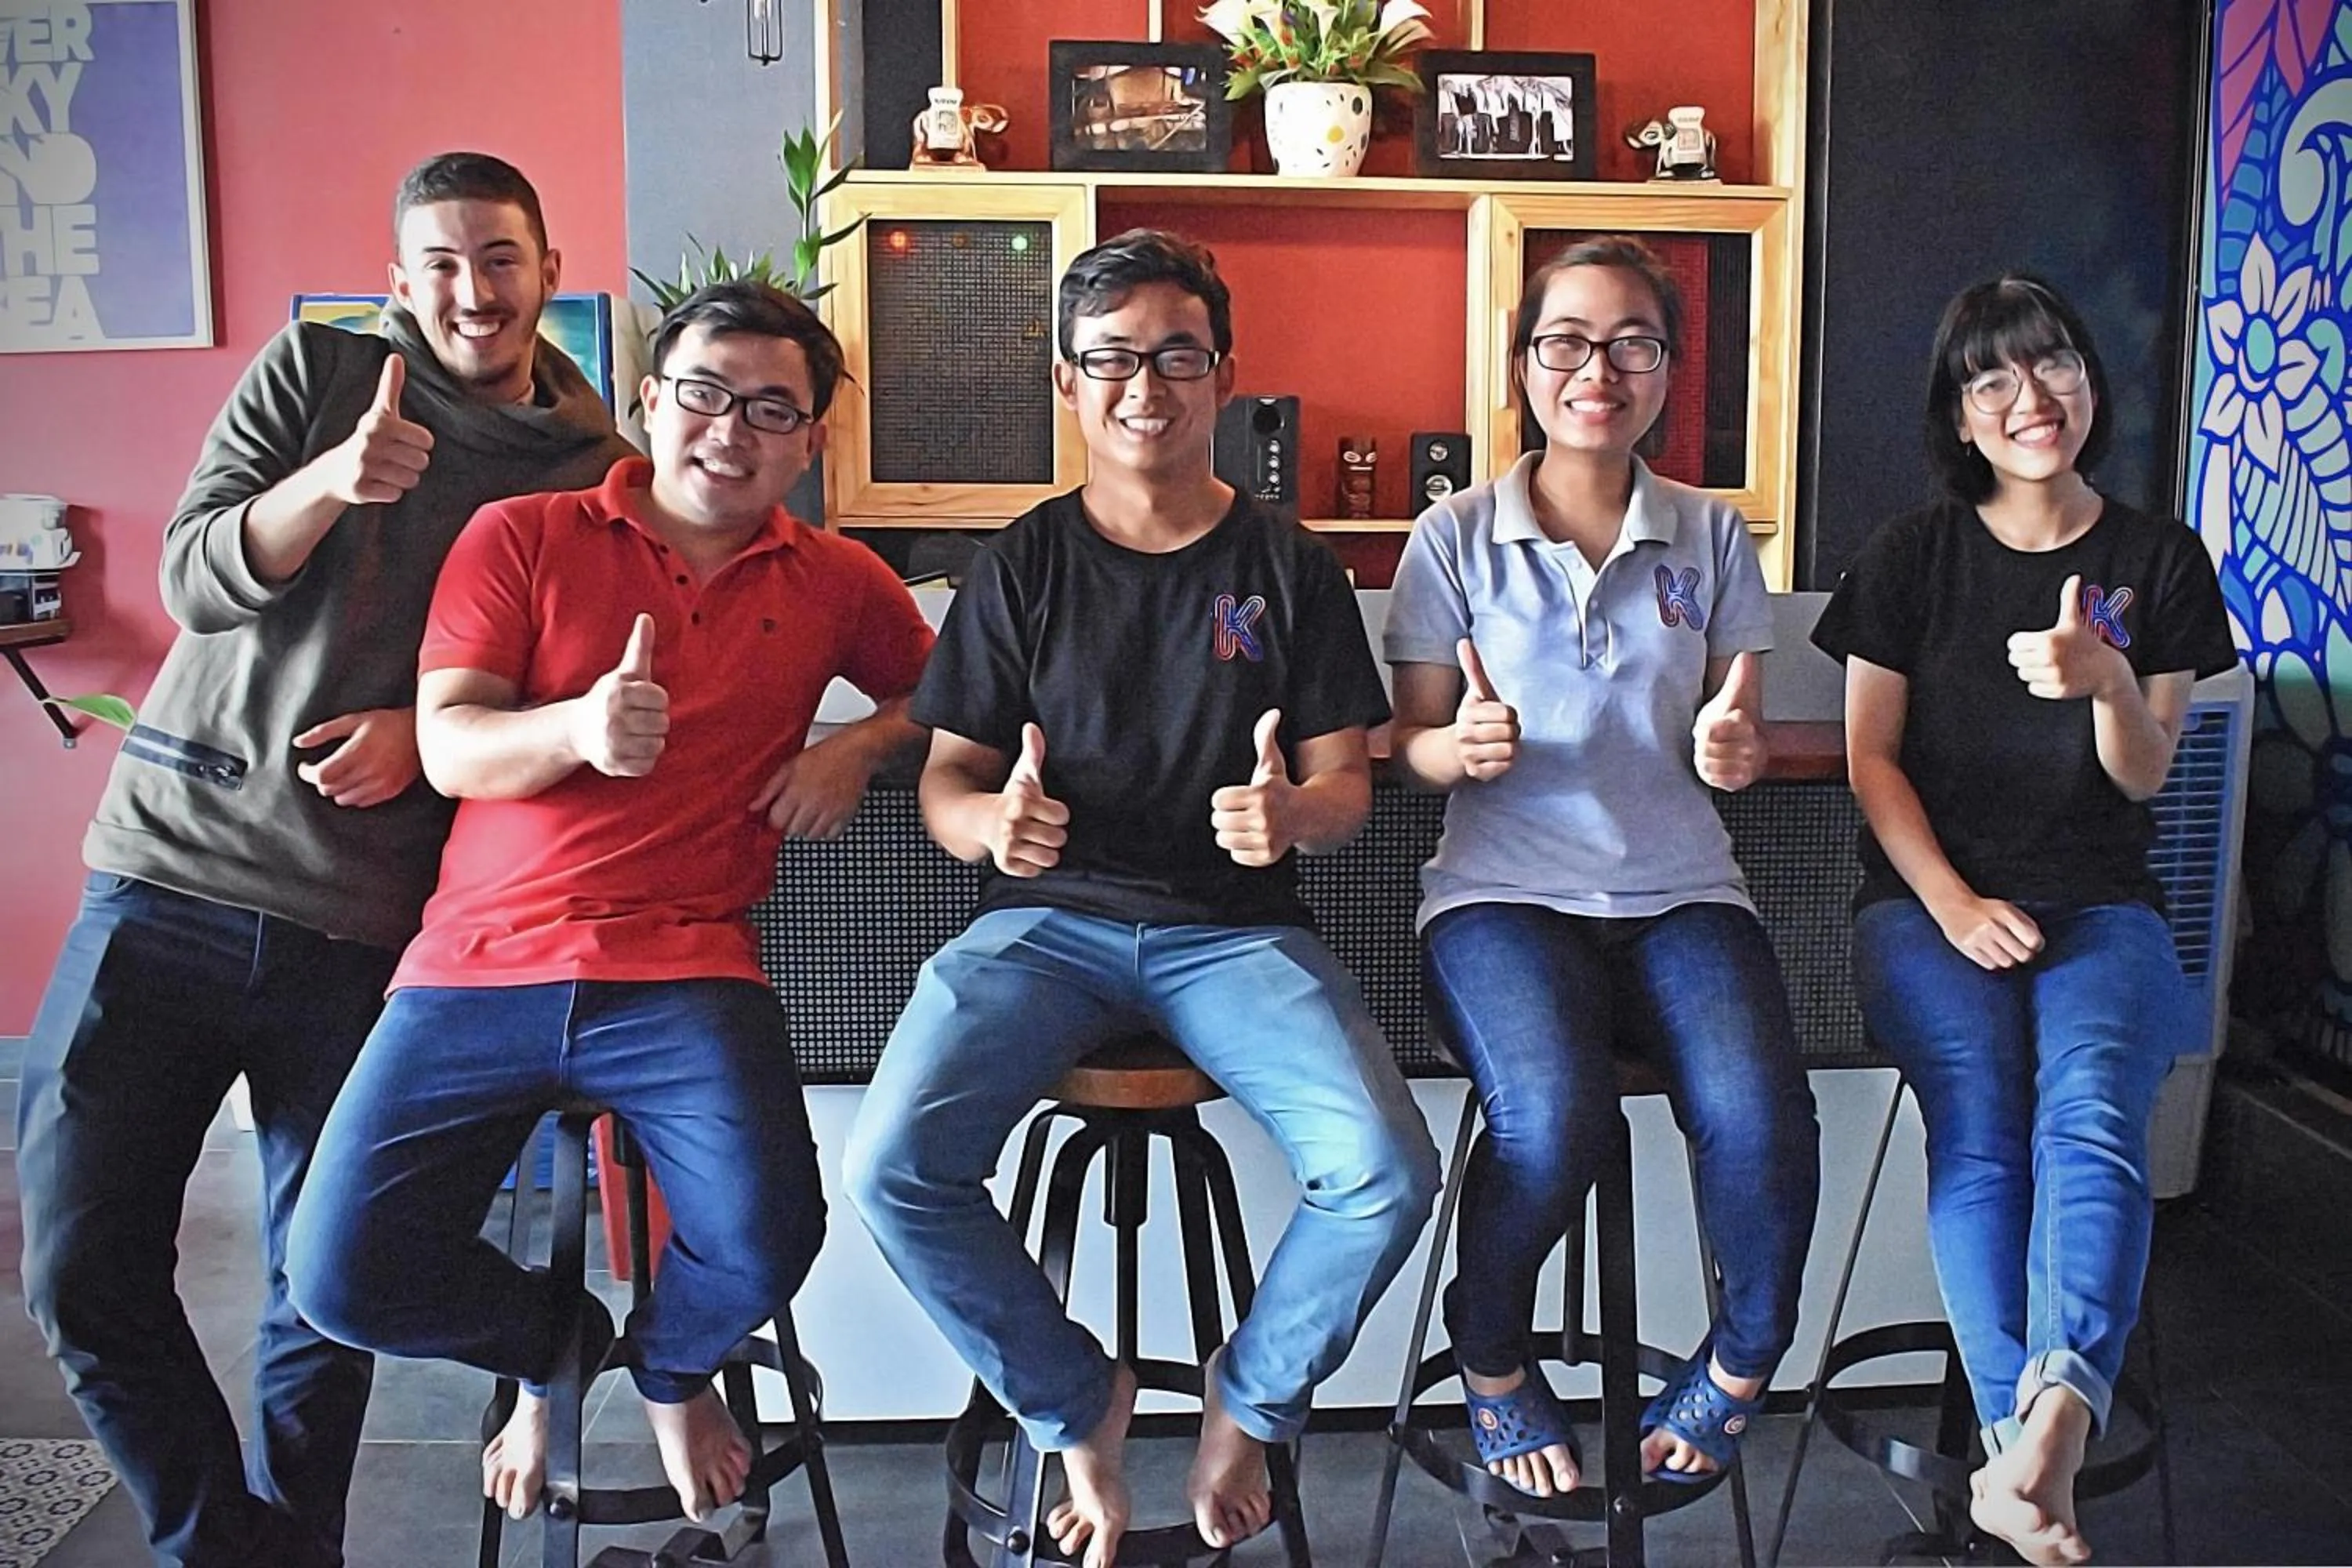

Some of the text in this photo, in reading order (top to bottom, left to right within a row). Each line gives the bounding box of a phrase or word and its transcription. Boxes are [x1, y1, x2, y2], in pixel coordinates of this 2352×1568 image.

[0, 204, 100, 275] HE
[0, 274, 106, 339] EA
[1214, 593, 1265, 661] K
[1653, 564, 1704, 631] K
[2083, 584, 2133, 648] K
